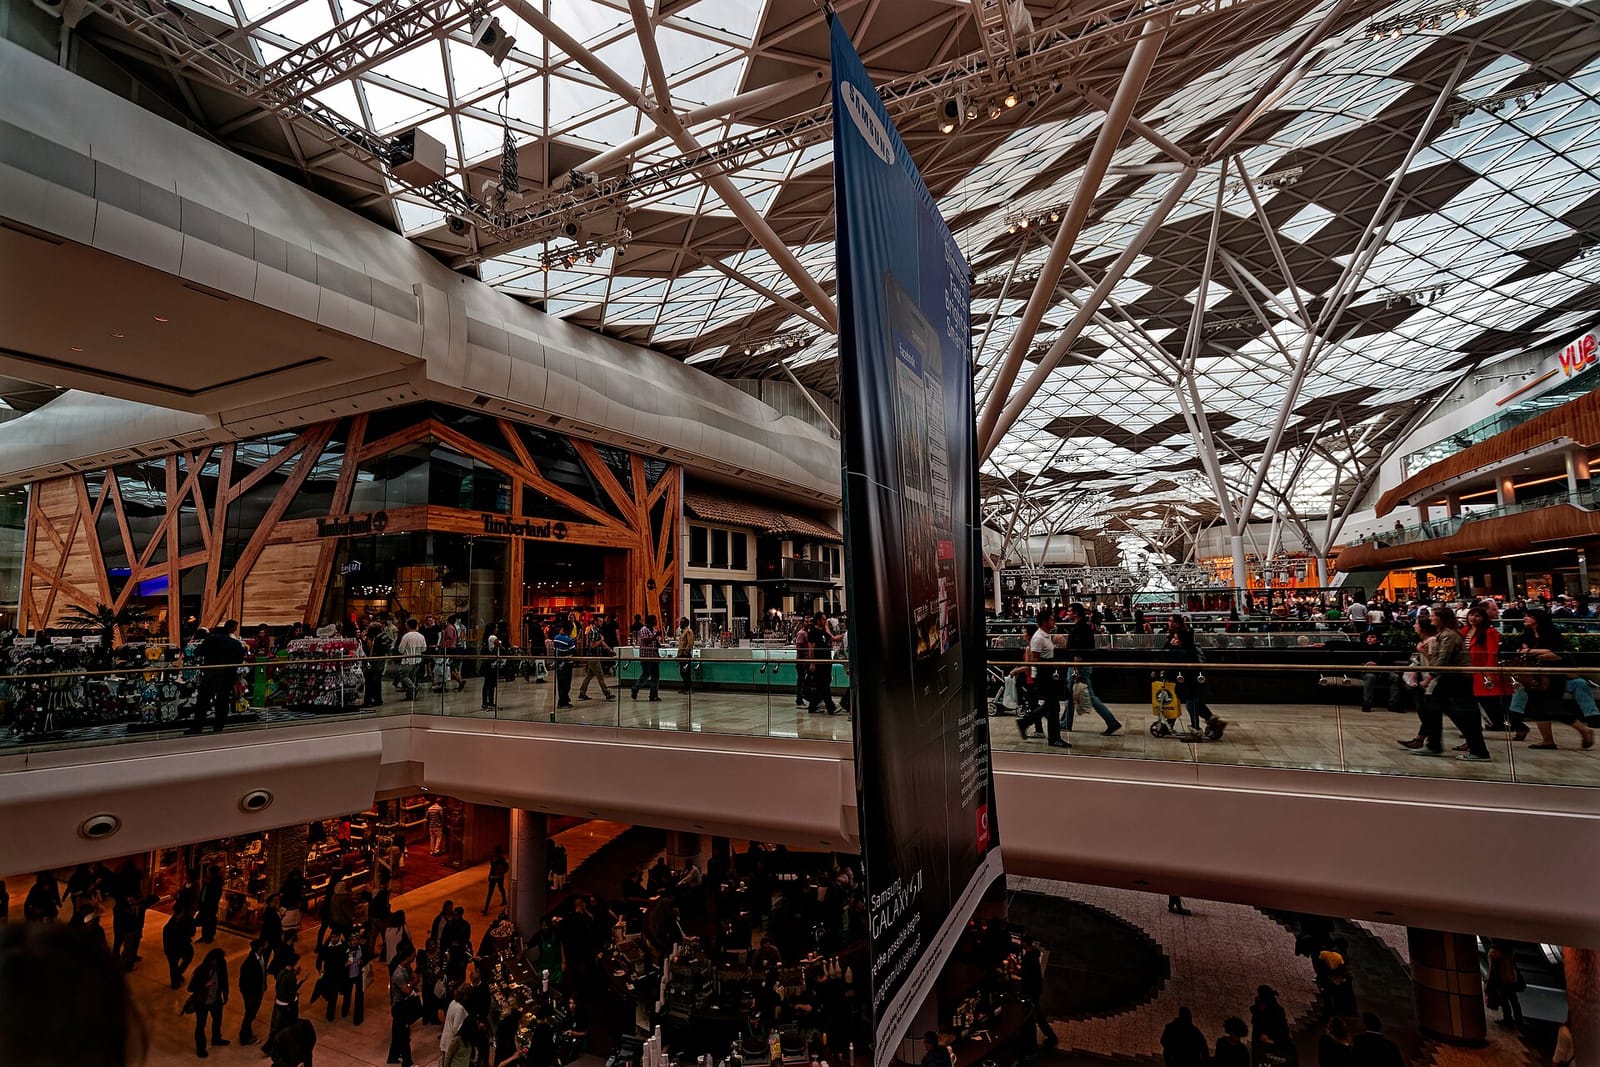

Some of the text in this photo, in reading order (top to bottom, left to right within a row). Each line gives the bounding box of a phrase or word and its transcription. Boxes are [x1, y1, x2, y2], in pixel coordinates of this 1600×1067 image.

[849, 84, 889, 164] SAMSUNG
[481, 513, 550, 537] Timberland
[871, 877, 902, 912] Samsung
[872, 883, 909, 940] GALAXY
